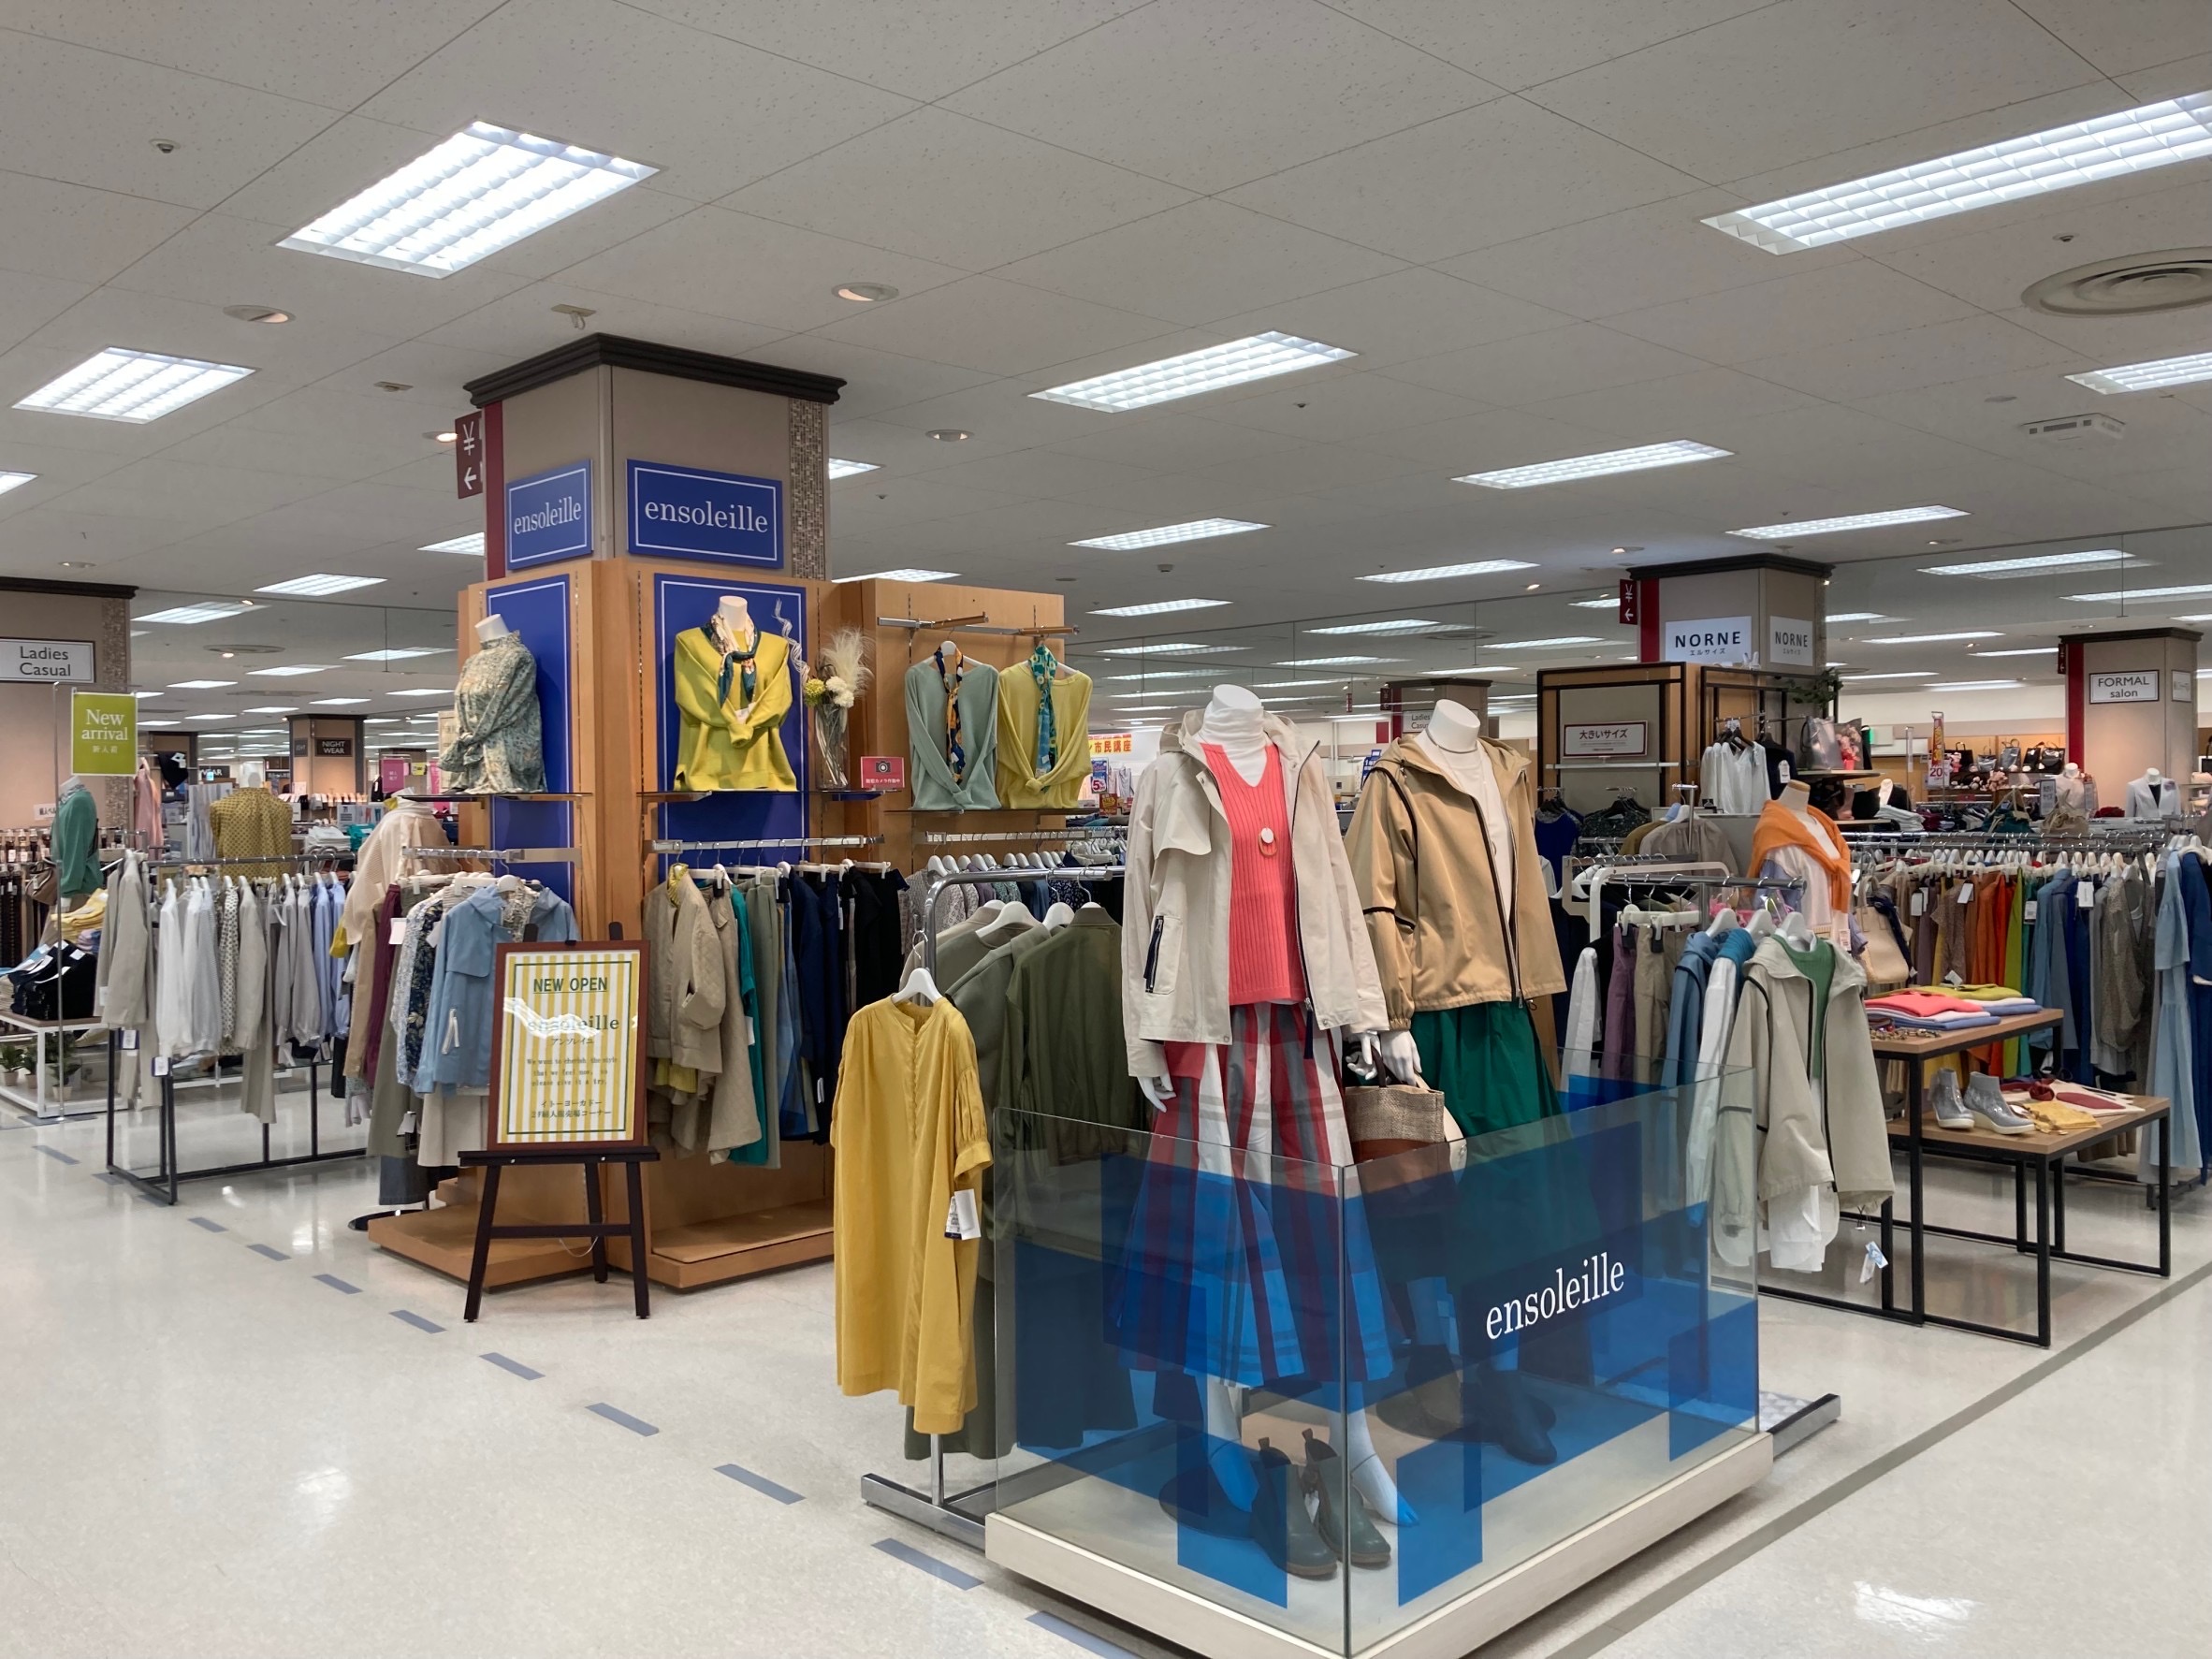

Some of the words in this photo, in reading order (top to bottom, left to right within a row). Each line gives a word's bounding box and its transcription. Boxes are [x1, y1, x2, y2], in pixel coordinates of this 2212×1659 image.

[514, 496, 582, 535] ensoleille
[645, 500, 768, 534] ensoleille
[1675, 631, 1741, 648] NORNE
[1775, 631, 1808, 648] NORNE
[20, 646, 68, 661] Ladies
[1689, 648, 1726, 656] エルサイズ
[20, 662, 71, 677] Casual
[2098, 676, 2150, 688] FORMAL
[2110, 688, 2138, 698] salon
[86, 708, 124, 725] New
[81, 727, 128, 741] arrival
[1579, 728, 1628, 740] 大きいサイズ
[533, 978, 564, 993] NEW
[570, 977, 608, 992] OPEN
[1486, 1251, 1624, 1340] ensoleille
